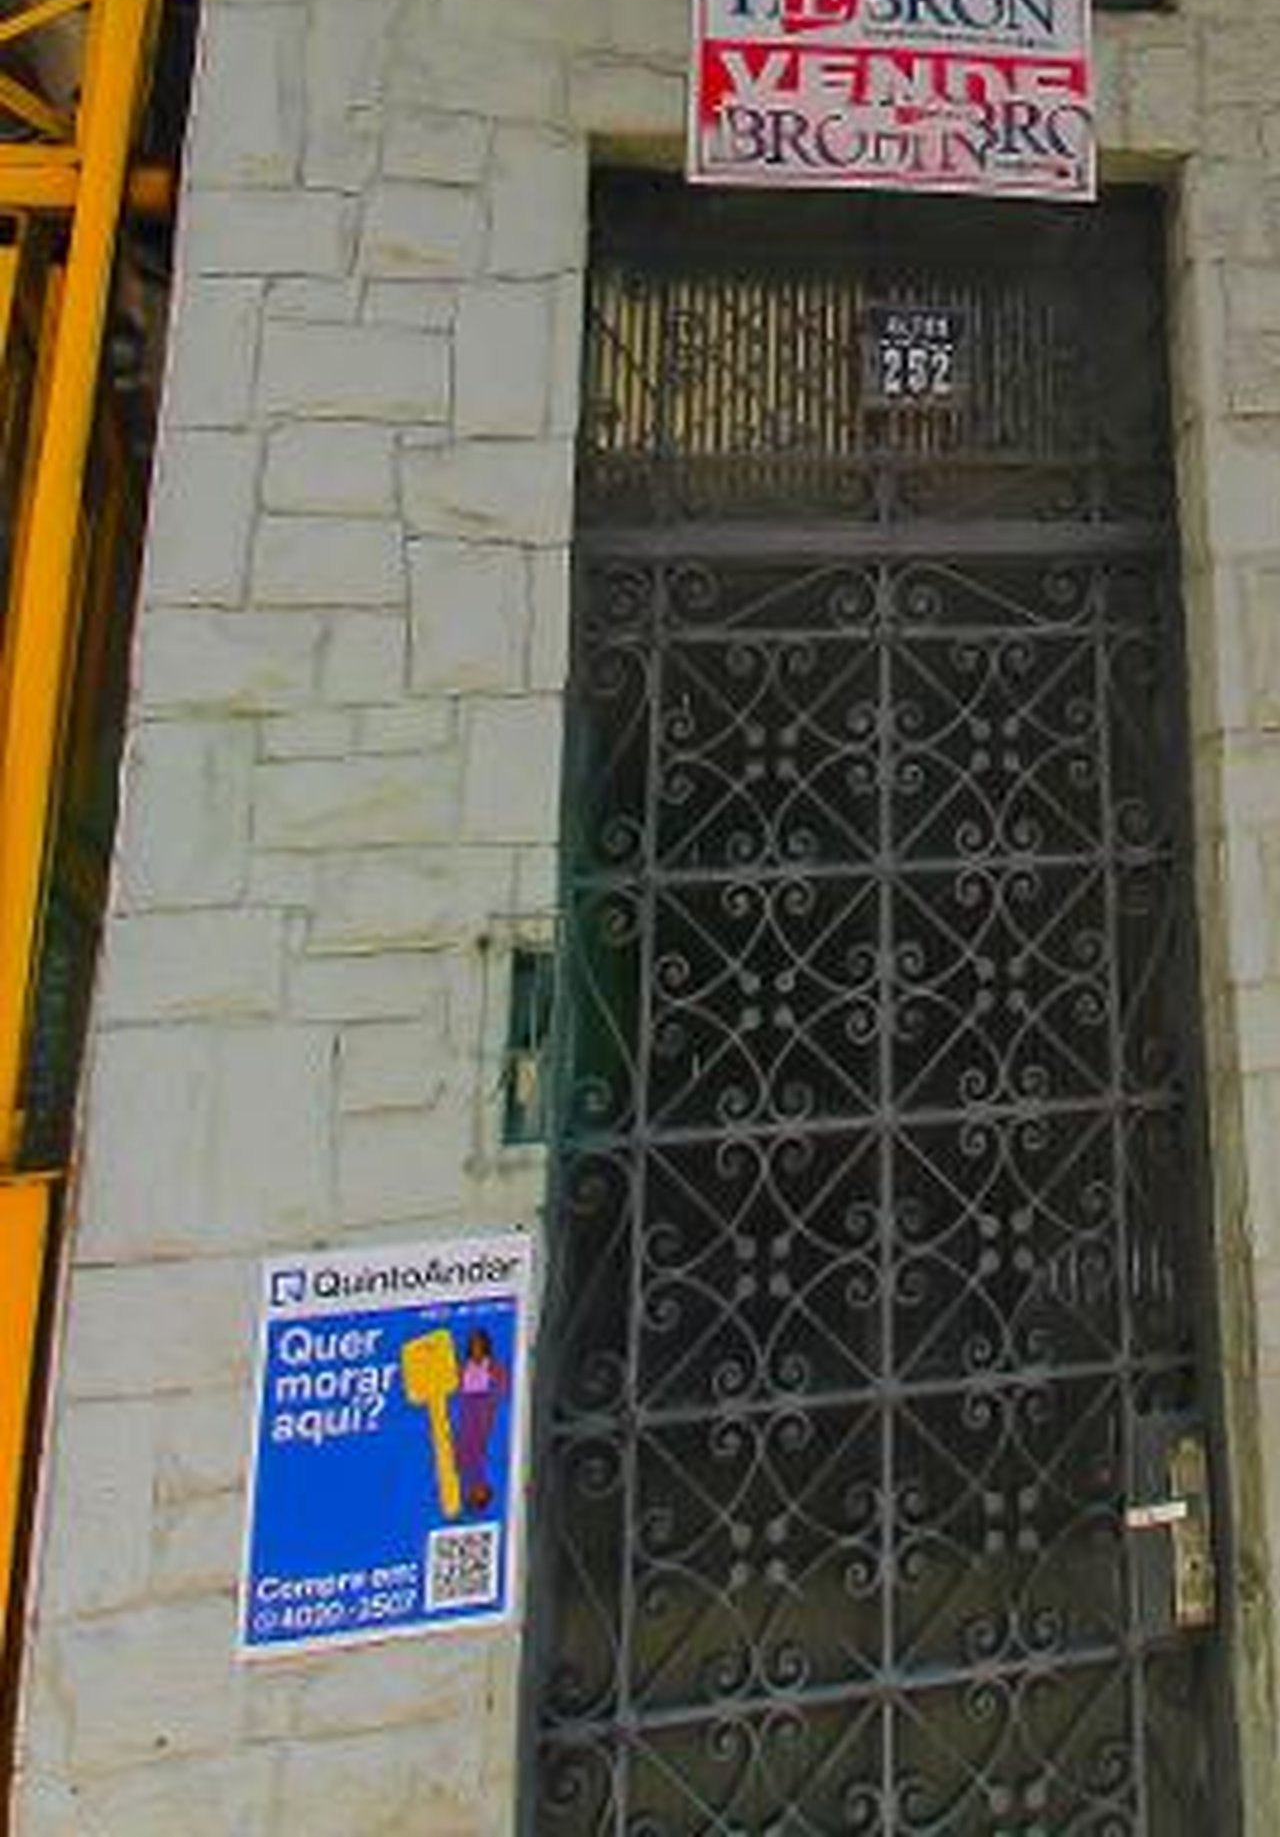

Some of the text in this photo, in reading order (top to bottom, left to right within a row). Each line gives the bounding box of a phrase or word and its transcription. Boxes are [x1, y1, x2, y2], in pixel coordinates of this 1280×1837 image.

[884, 348, 951, 395] 252
[313, 1255, 523, 1298] QuintoAndar
[279, 1328, 384, 1365] Quer
[275, 1363, 397, 1402] morar
[271, 1398, 385, 1446] aqui?
